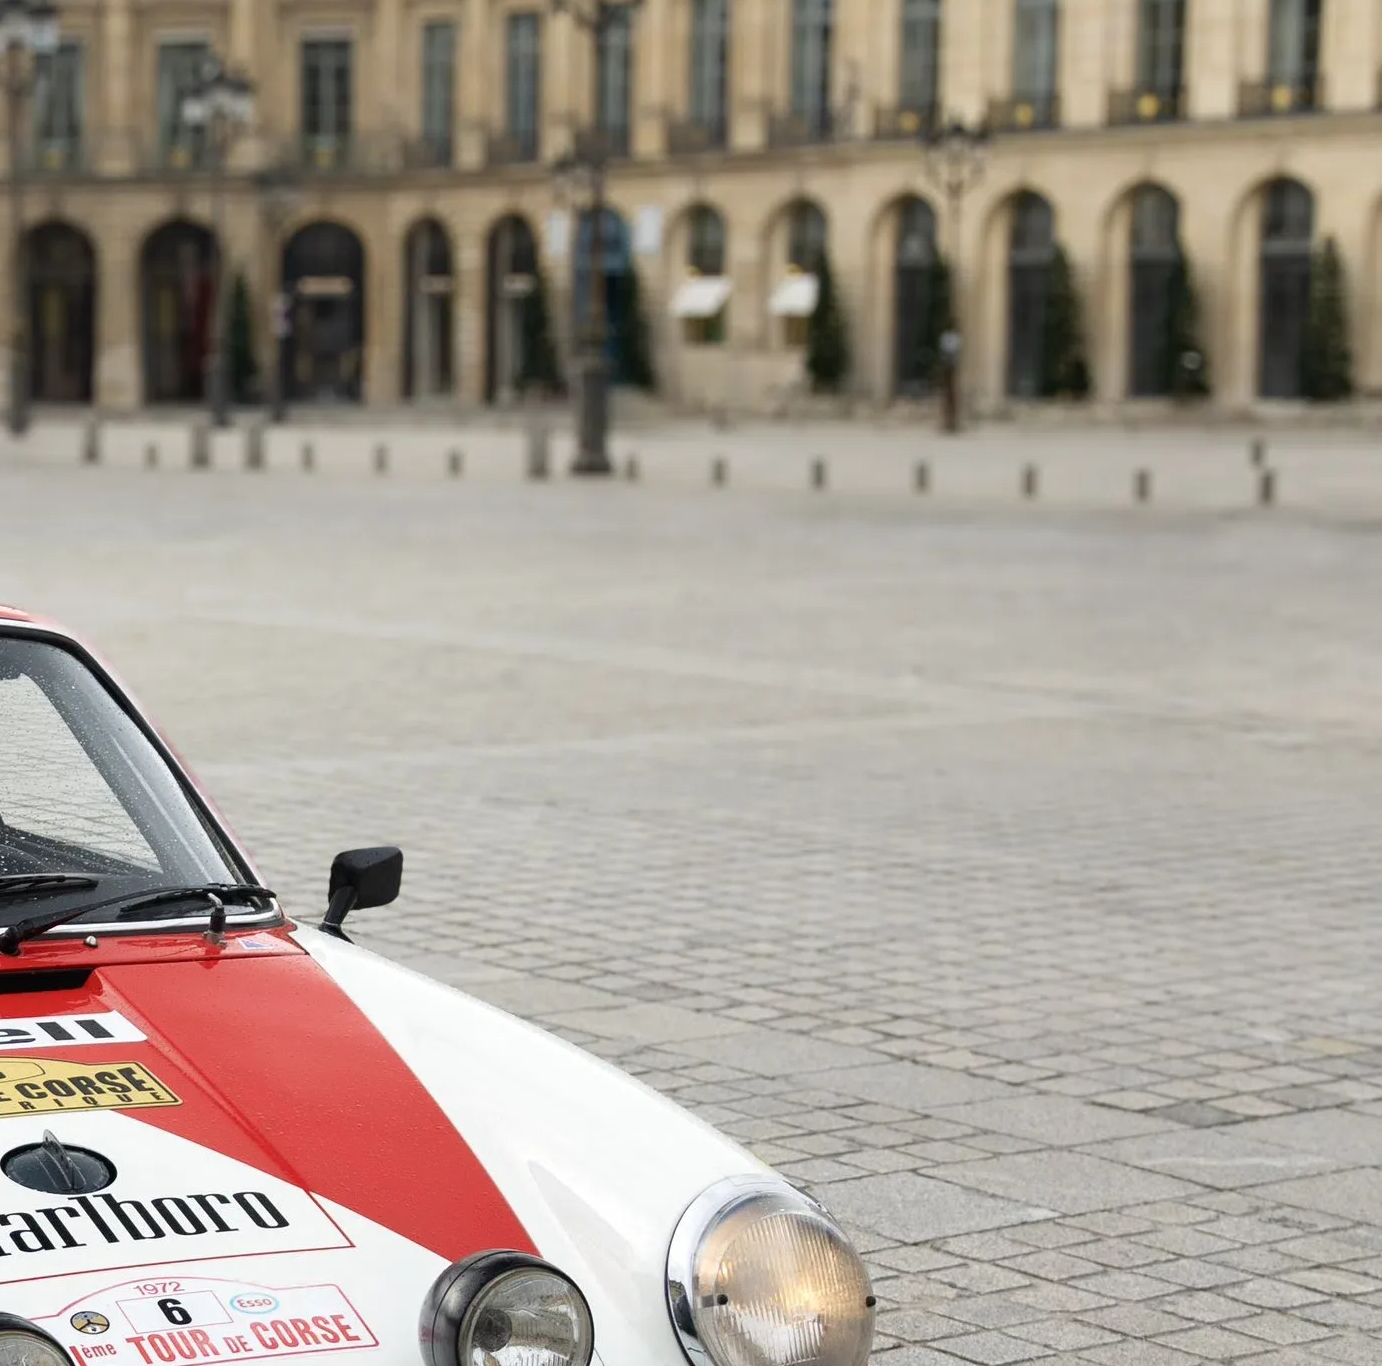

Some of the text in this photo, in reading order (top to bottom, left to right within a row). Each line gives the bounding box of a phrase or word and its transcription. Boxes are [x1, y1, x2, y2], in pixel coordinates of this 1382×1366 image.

[14, 1067, 154, 1100] CORSE
[133, 1281, 185, 1296] 1972
[157, 1298, 192, 1325] 6
[126, 1329, 221, 1364] TOUR
[223, 1335, 254, 1354] DE
[249, 1314, 361, 1350] CORSE
